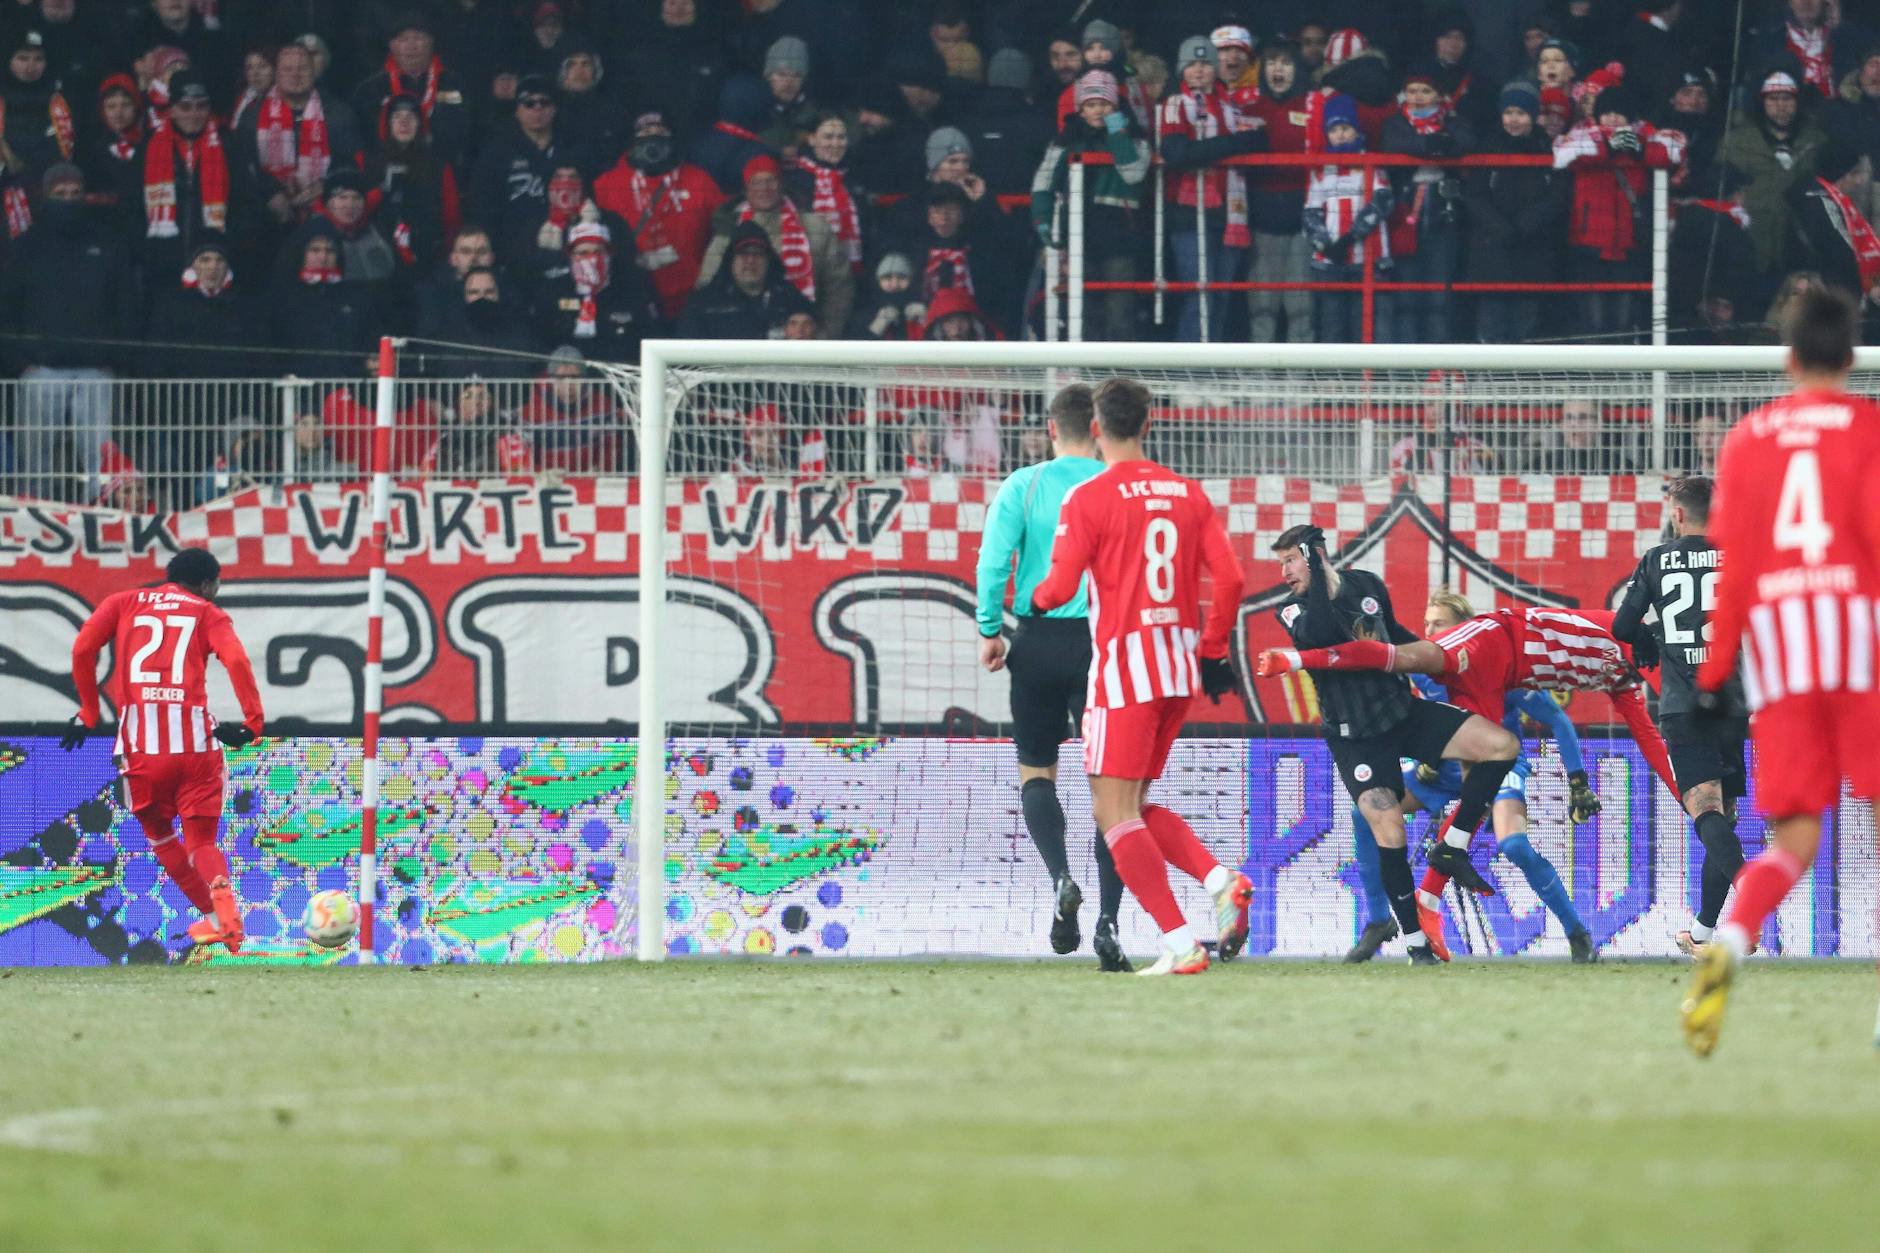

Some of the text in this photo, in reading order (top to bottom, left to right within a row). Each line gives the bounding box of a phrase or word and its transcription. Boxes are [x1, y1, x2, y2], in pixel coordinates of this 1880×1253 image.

[705, 485, 903, 547] WIRD
[1131, 480, 1151, 497] FC
[1773, 449, 1834, 566] 4
[1144, 517, 1178, 604] 8
[148, 592, 164, 604] FC
[130, 614, 197, 685] 27
[142, 686, 184, 701] BECKER
